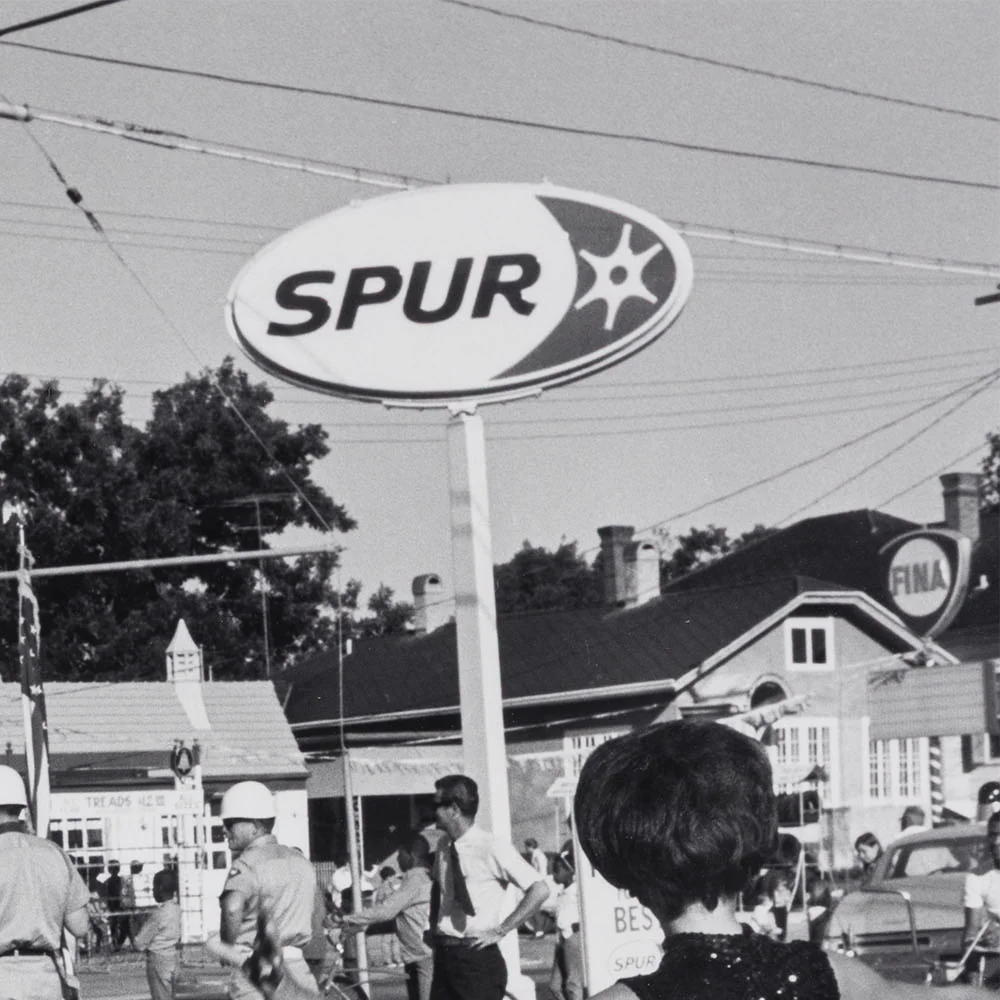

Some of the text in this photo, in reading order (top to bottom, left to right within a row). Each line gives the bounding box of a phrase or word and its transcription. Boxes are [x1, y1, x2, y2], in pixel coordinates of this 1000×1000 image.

[267, 253, 541, 337] SPUR
[891, 559, 949, 597] FINA
[85, 795, 132, 808] TREADS
[614, 906, 654, 933] BES
[613, 955, 657, 972] SPUR
